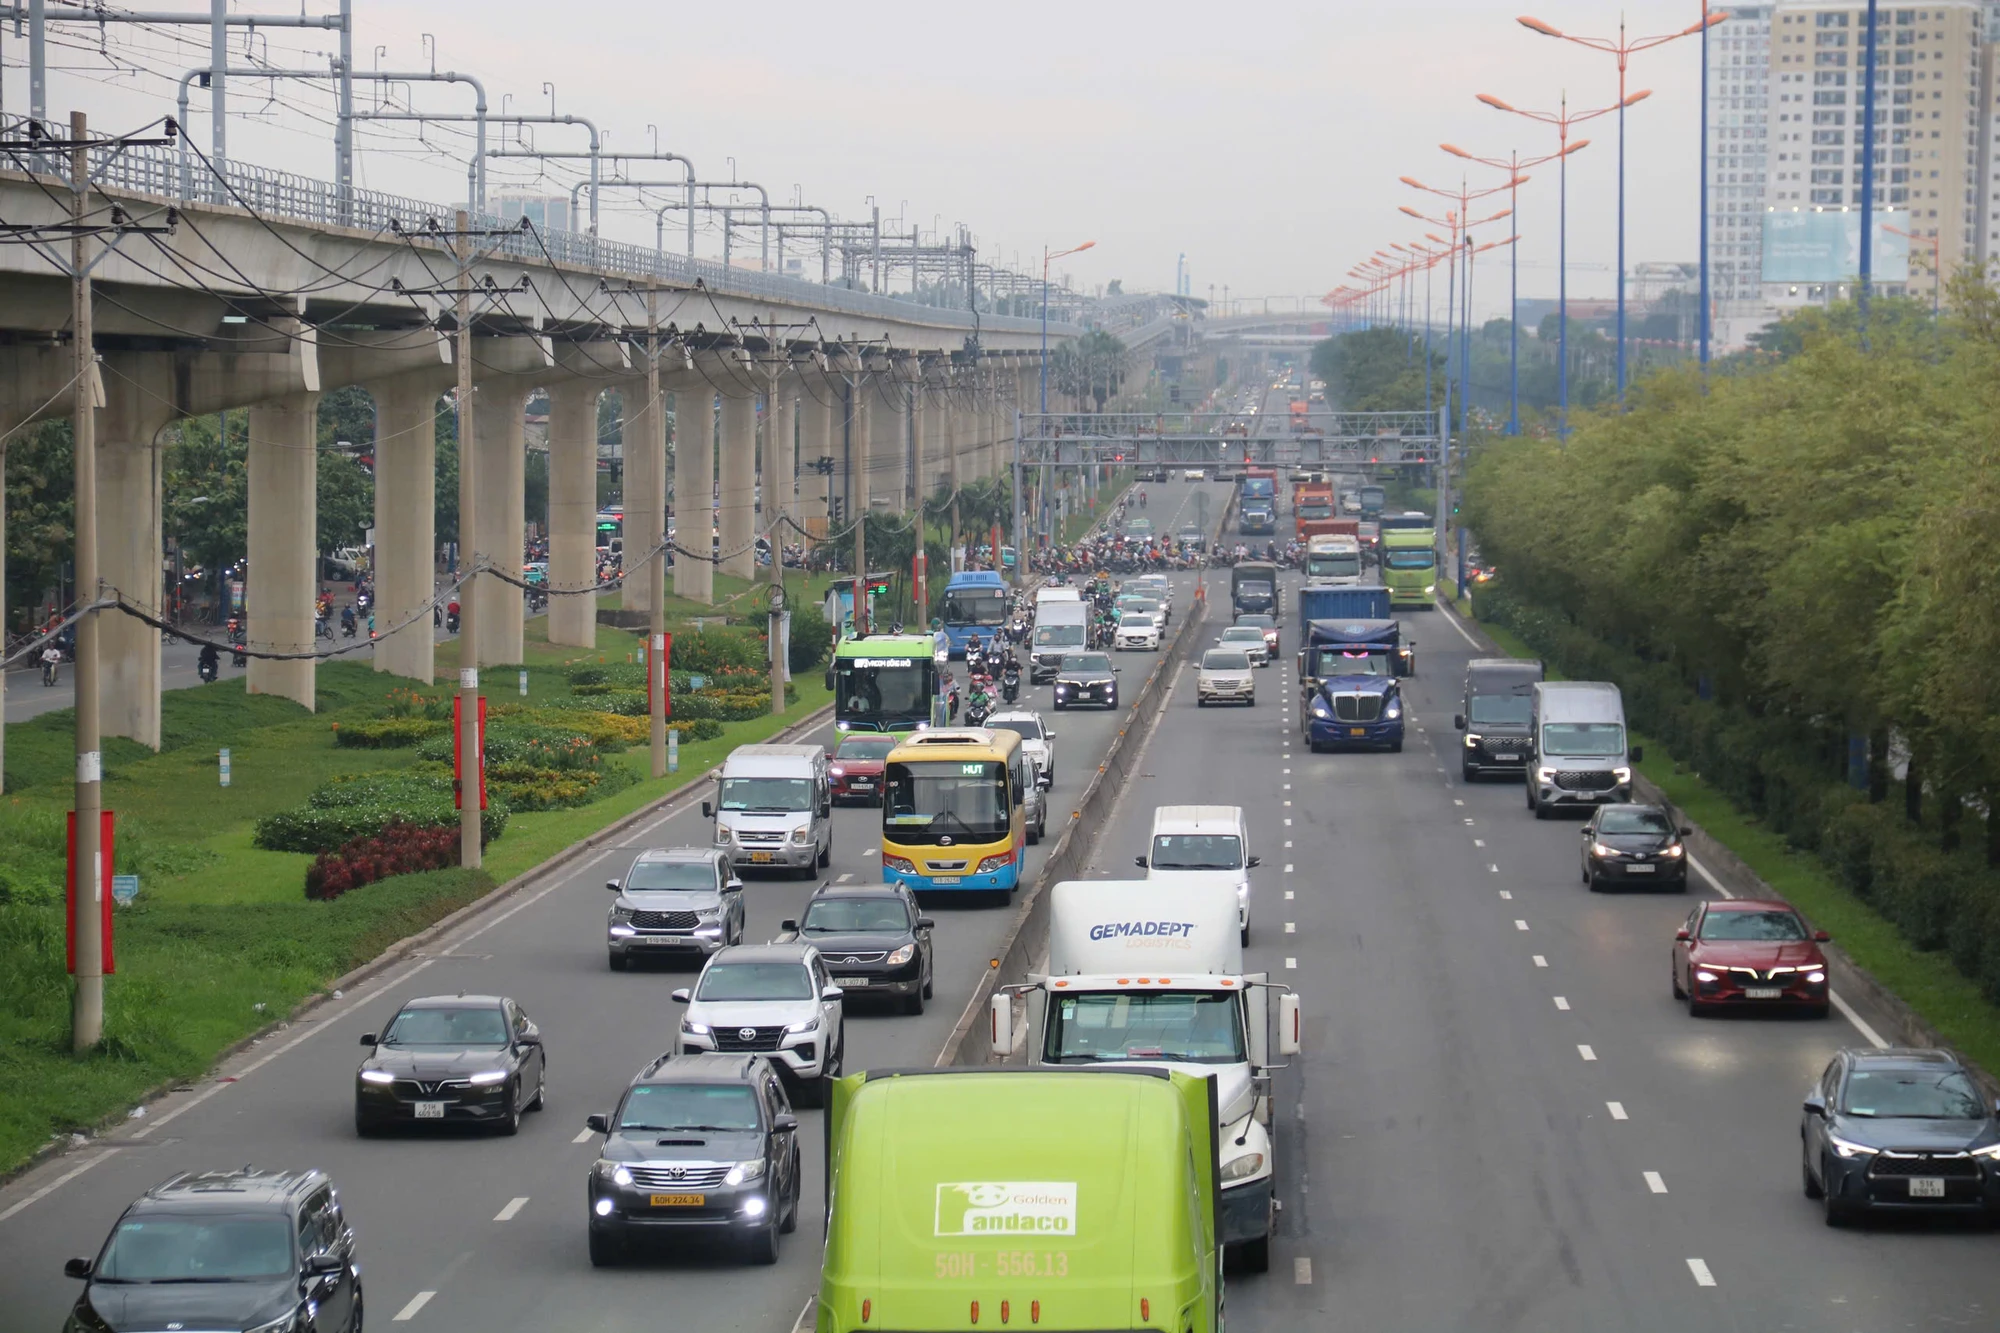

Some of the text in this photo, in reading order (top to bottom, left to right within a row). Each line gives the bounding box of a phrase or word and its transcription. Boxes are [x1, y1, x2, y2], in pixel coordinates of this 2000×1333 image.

[963, 764, 983, 774] HUT
[1090, 922, 1193, 941] GEMADEPT
[1126, 938, 1192, 950] LOGISTICS
[1013, 1195, 1068, 1205] Golden
[934, 1253, 974, 1278] 50H
[997, 1251, 1068, 1277] 556.13
